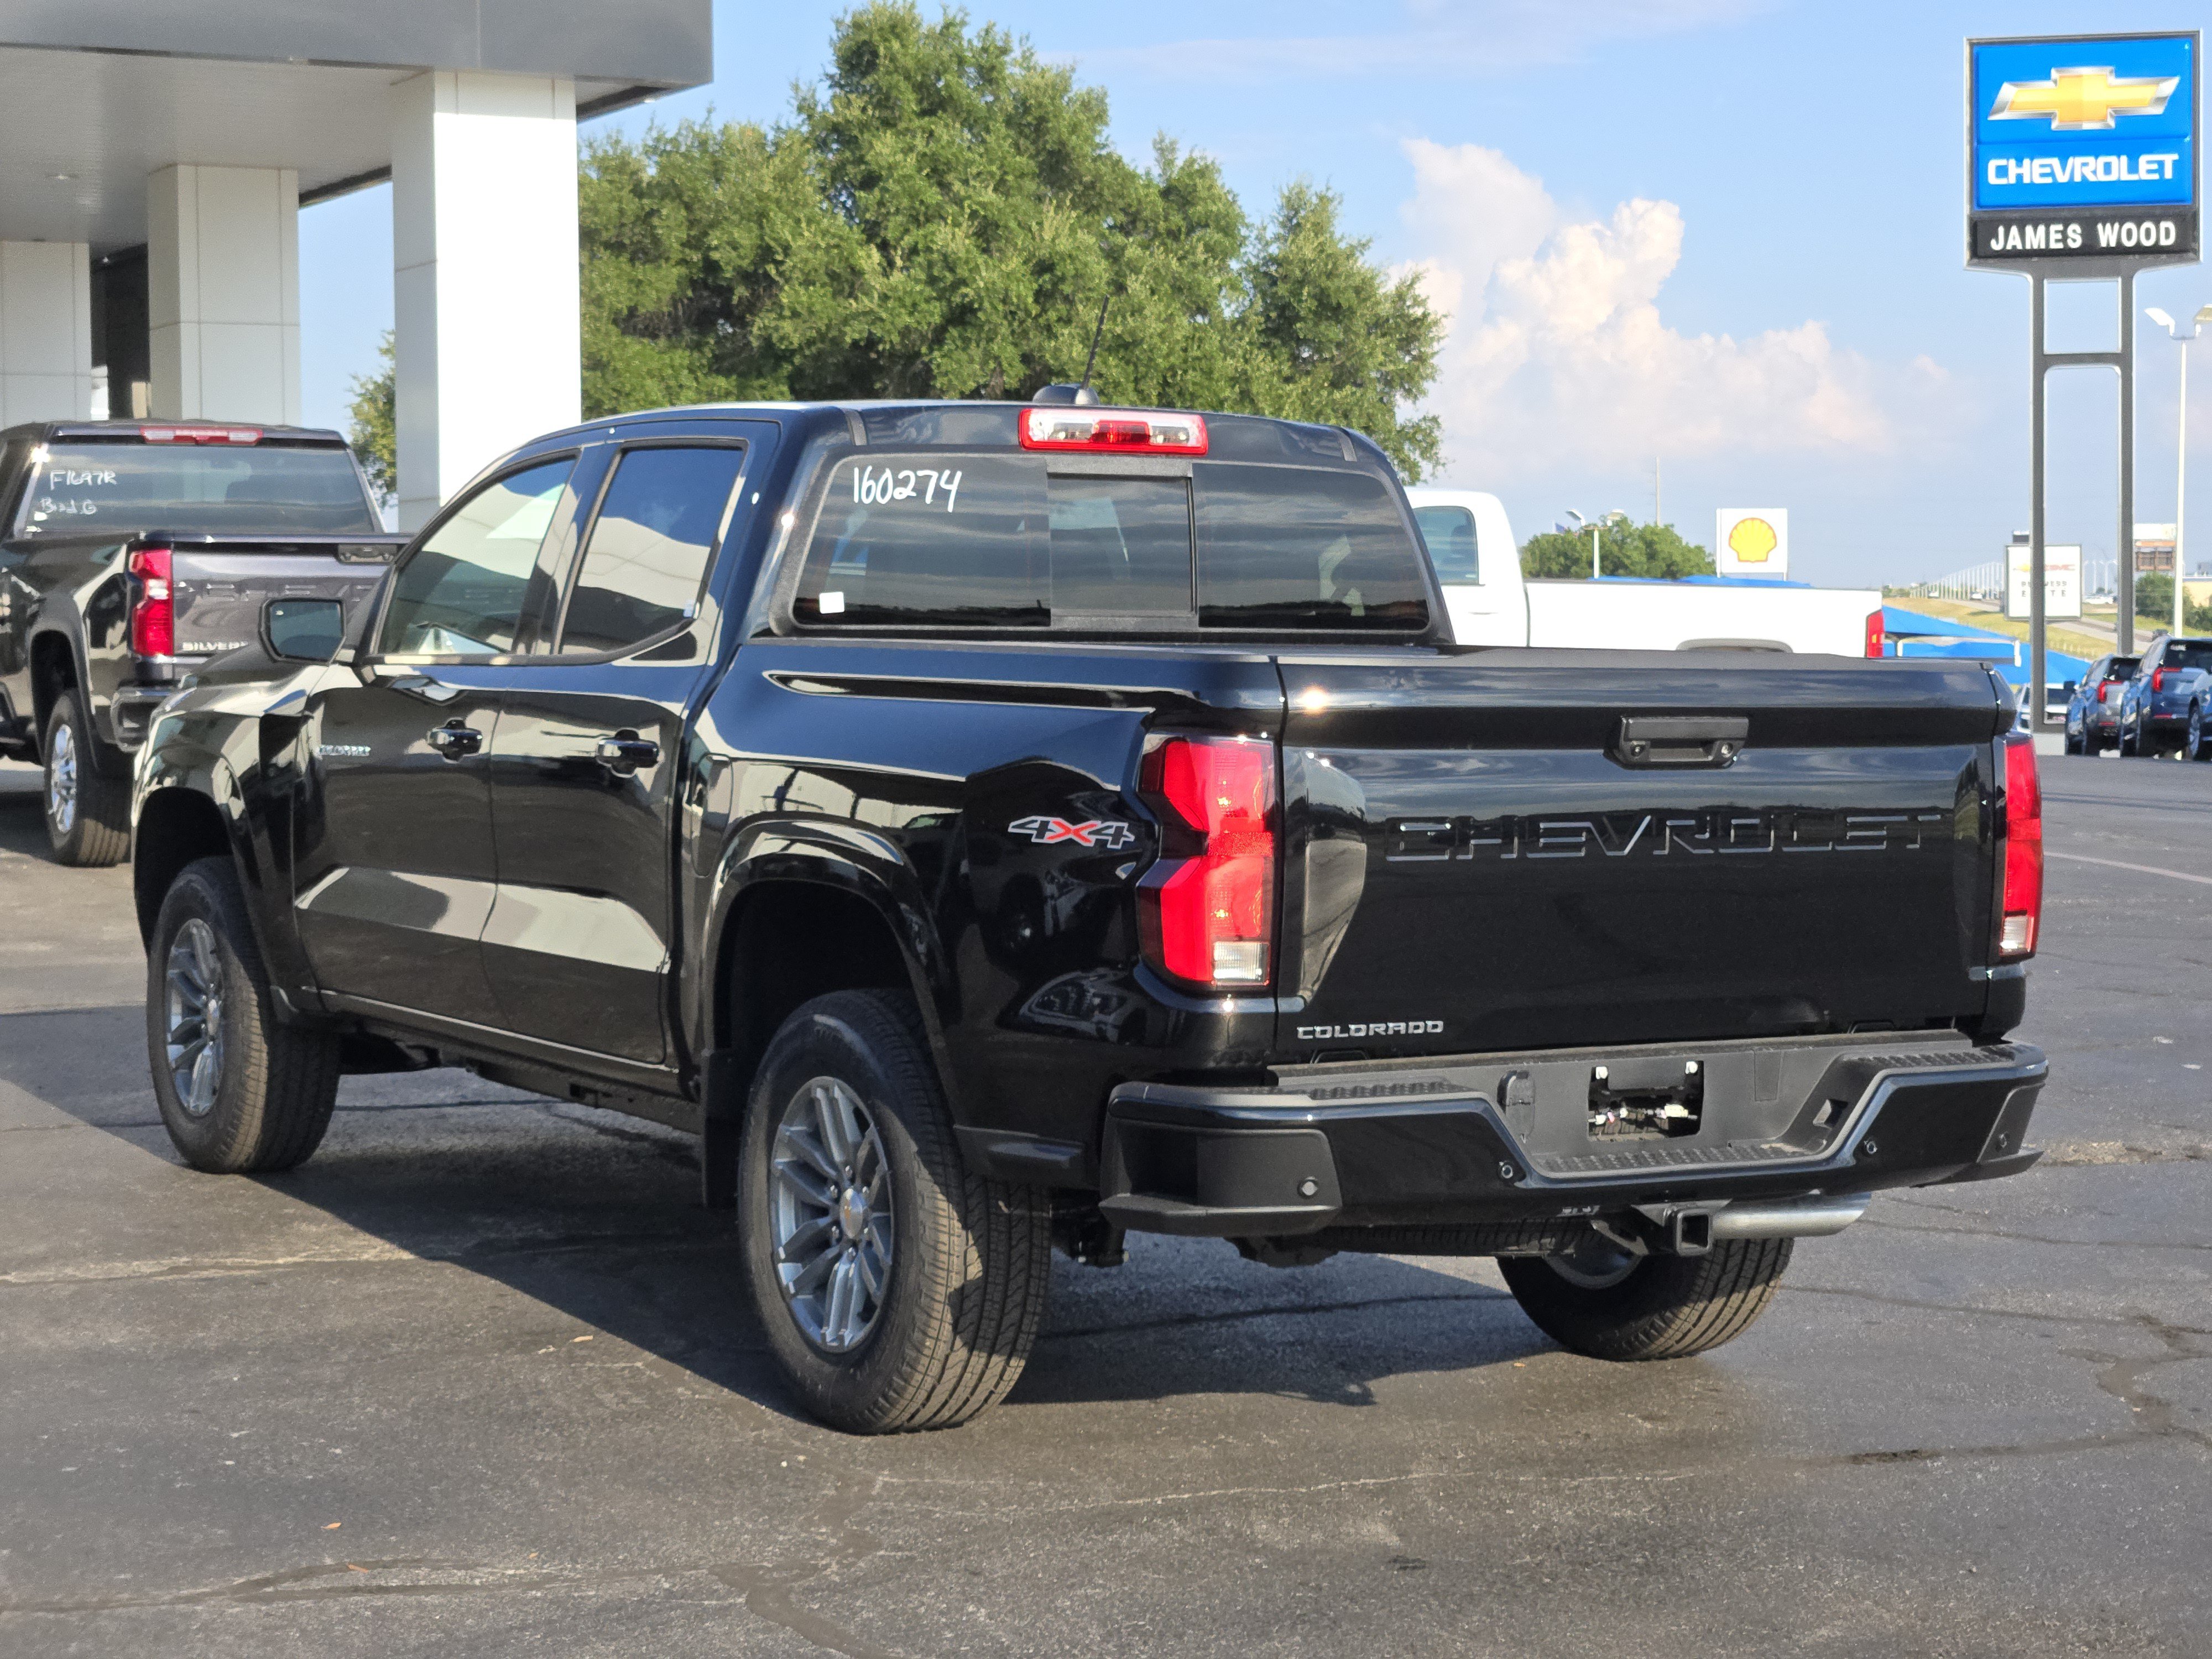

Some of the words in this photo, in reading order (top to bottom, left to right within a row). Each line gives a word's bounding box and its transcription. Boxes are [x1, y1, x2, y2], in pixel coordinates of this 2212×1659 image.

[1987, 153, 2179, 184] CHEVROLET
[1990, 224, 2083, 251] JAMES
[2097, 221, 2176, 247] WOOD
[853, 465, 962, 513] 160274
[1385, 810, 1943, 861] CHEVROLET
[1296, 1020, 1444, 1039] COLORADO
